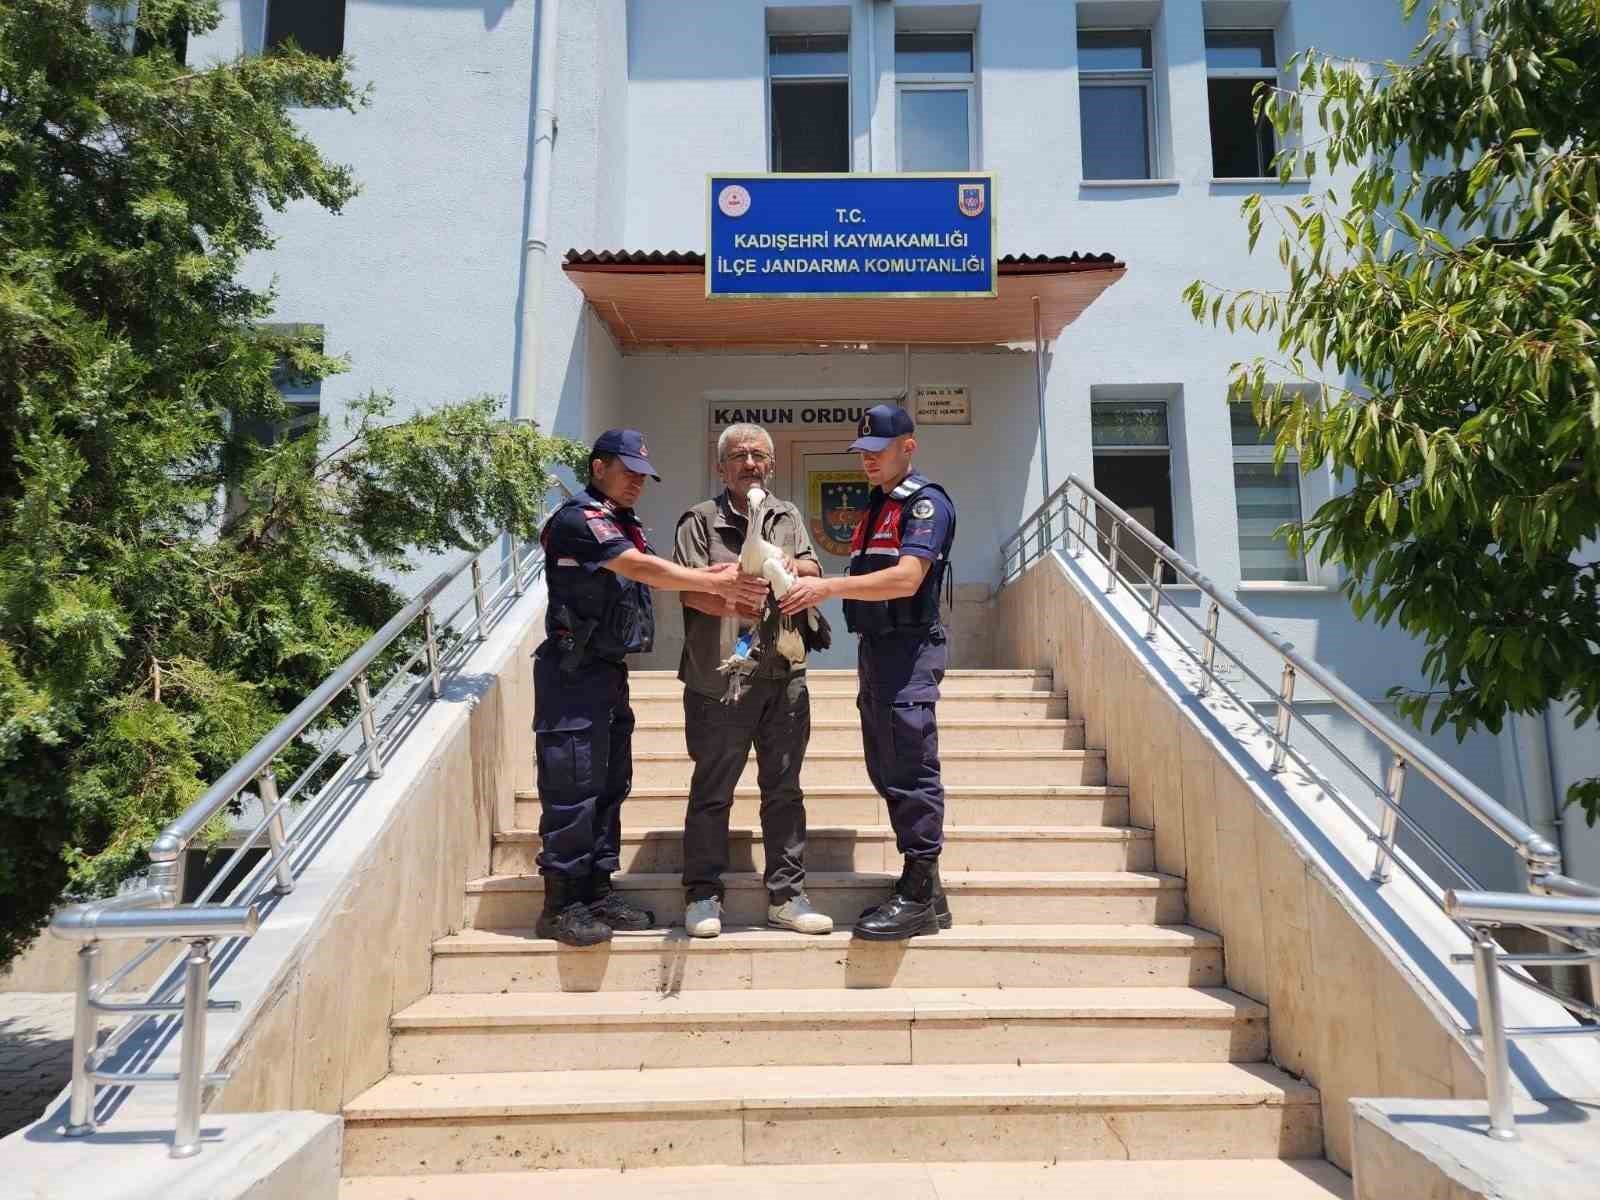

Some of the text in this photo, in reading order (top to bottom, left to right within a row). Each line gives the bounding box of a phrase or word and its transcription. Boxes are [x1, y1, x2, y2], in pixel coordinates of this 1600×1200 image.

[836, 208, 866, 223] T.C.
[734, 230, 968, 251] KADIŞEHRİ KAYMAKAMLIĞI
[718, 256, 985, 276] İLÇE JANDARMA KOMUTANLIĞI
[714, 408, 793, 424] KANUN
